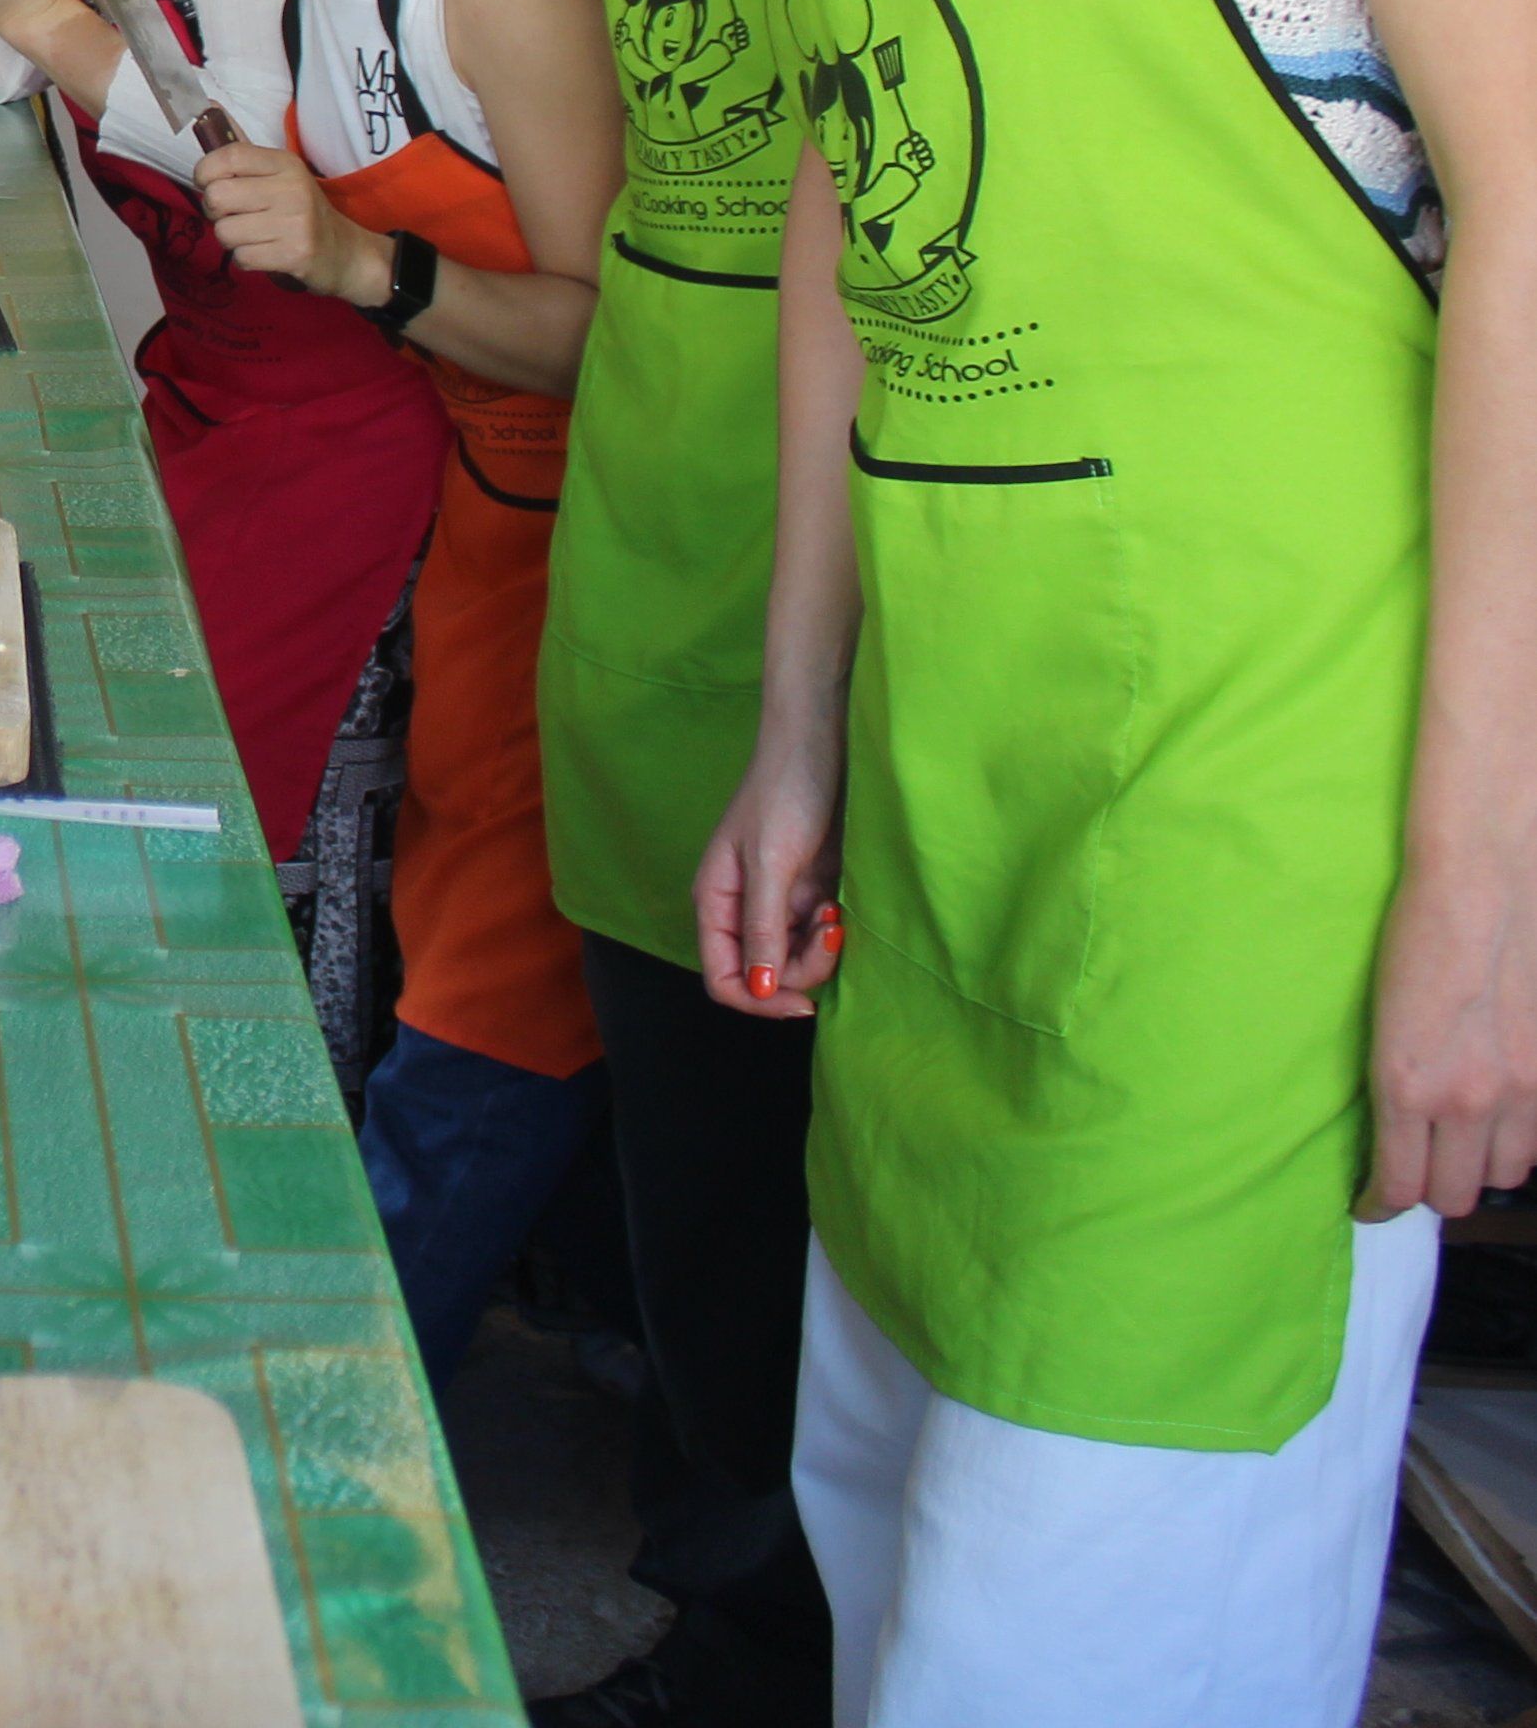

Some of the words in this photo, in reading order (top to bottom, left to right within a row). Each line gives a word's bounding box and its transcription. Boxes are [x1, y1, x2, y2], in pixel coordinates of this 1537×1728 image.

[688, 128, 748, 169] TASTY
[642, 190, 707, 221] Cooking
[715, 194, 790, 218] Schoo
[897, 272, 959, 318] TASTY
[916, 348, 1020, 384] School
